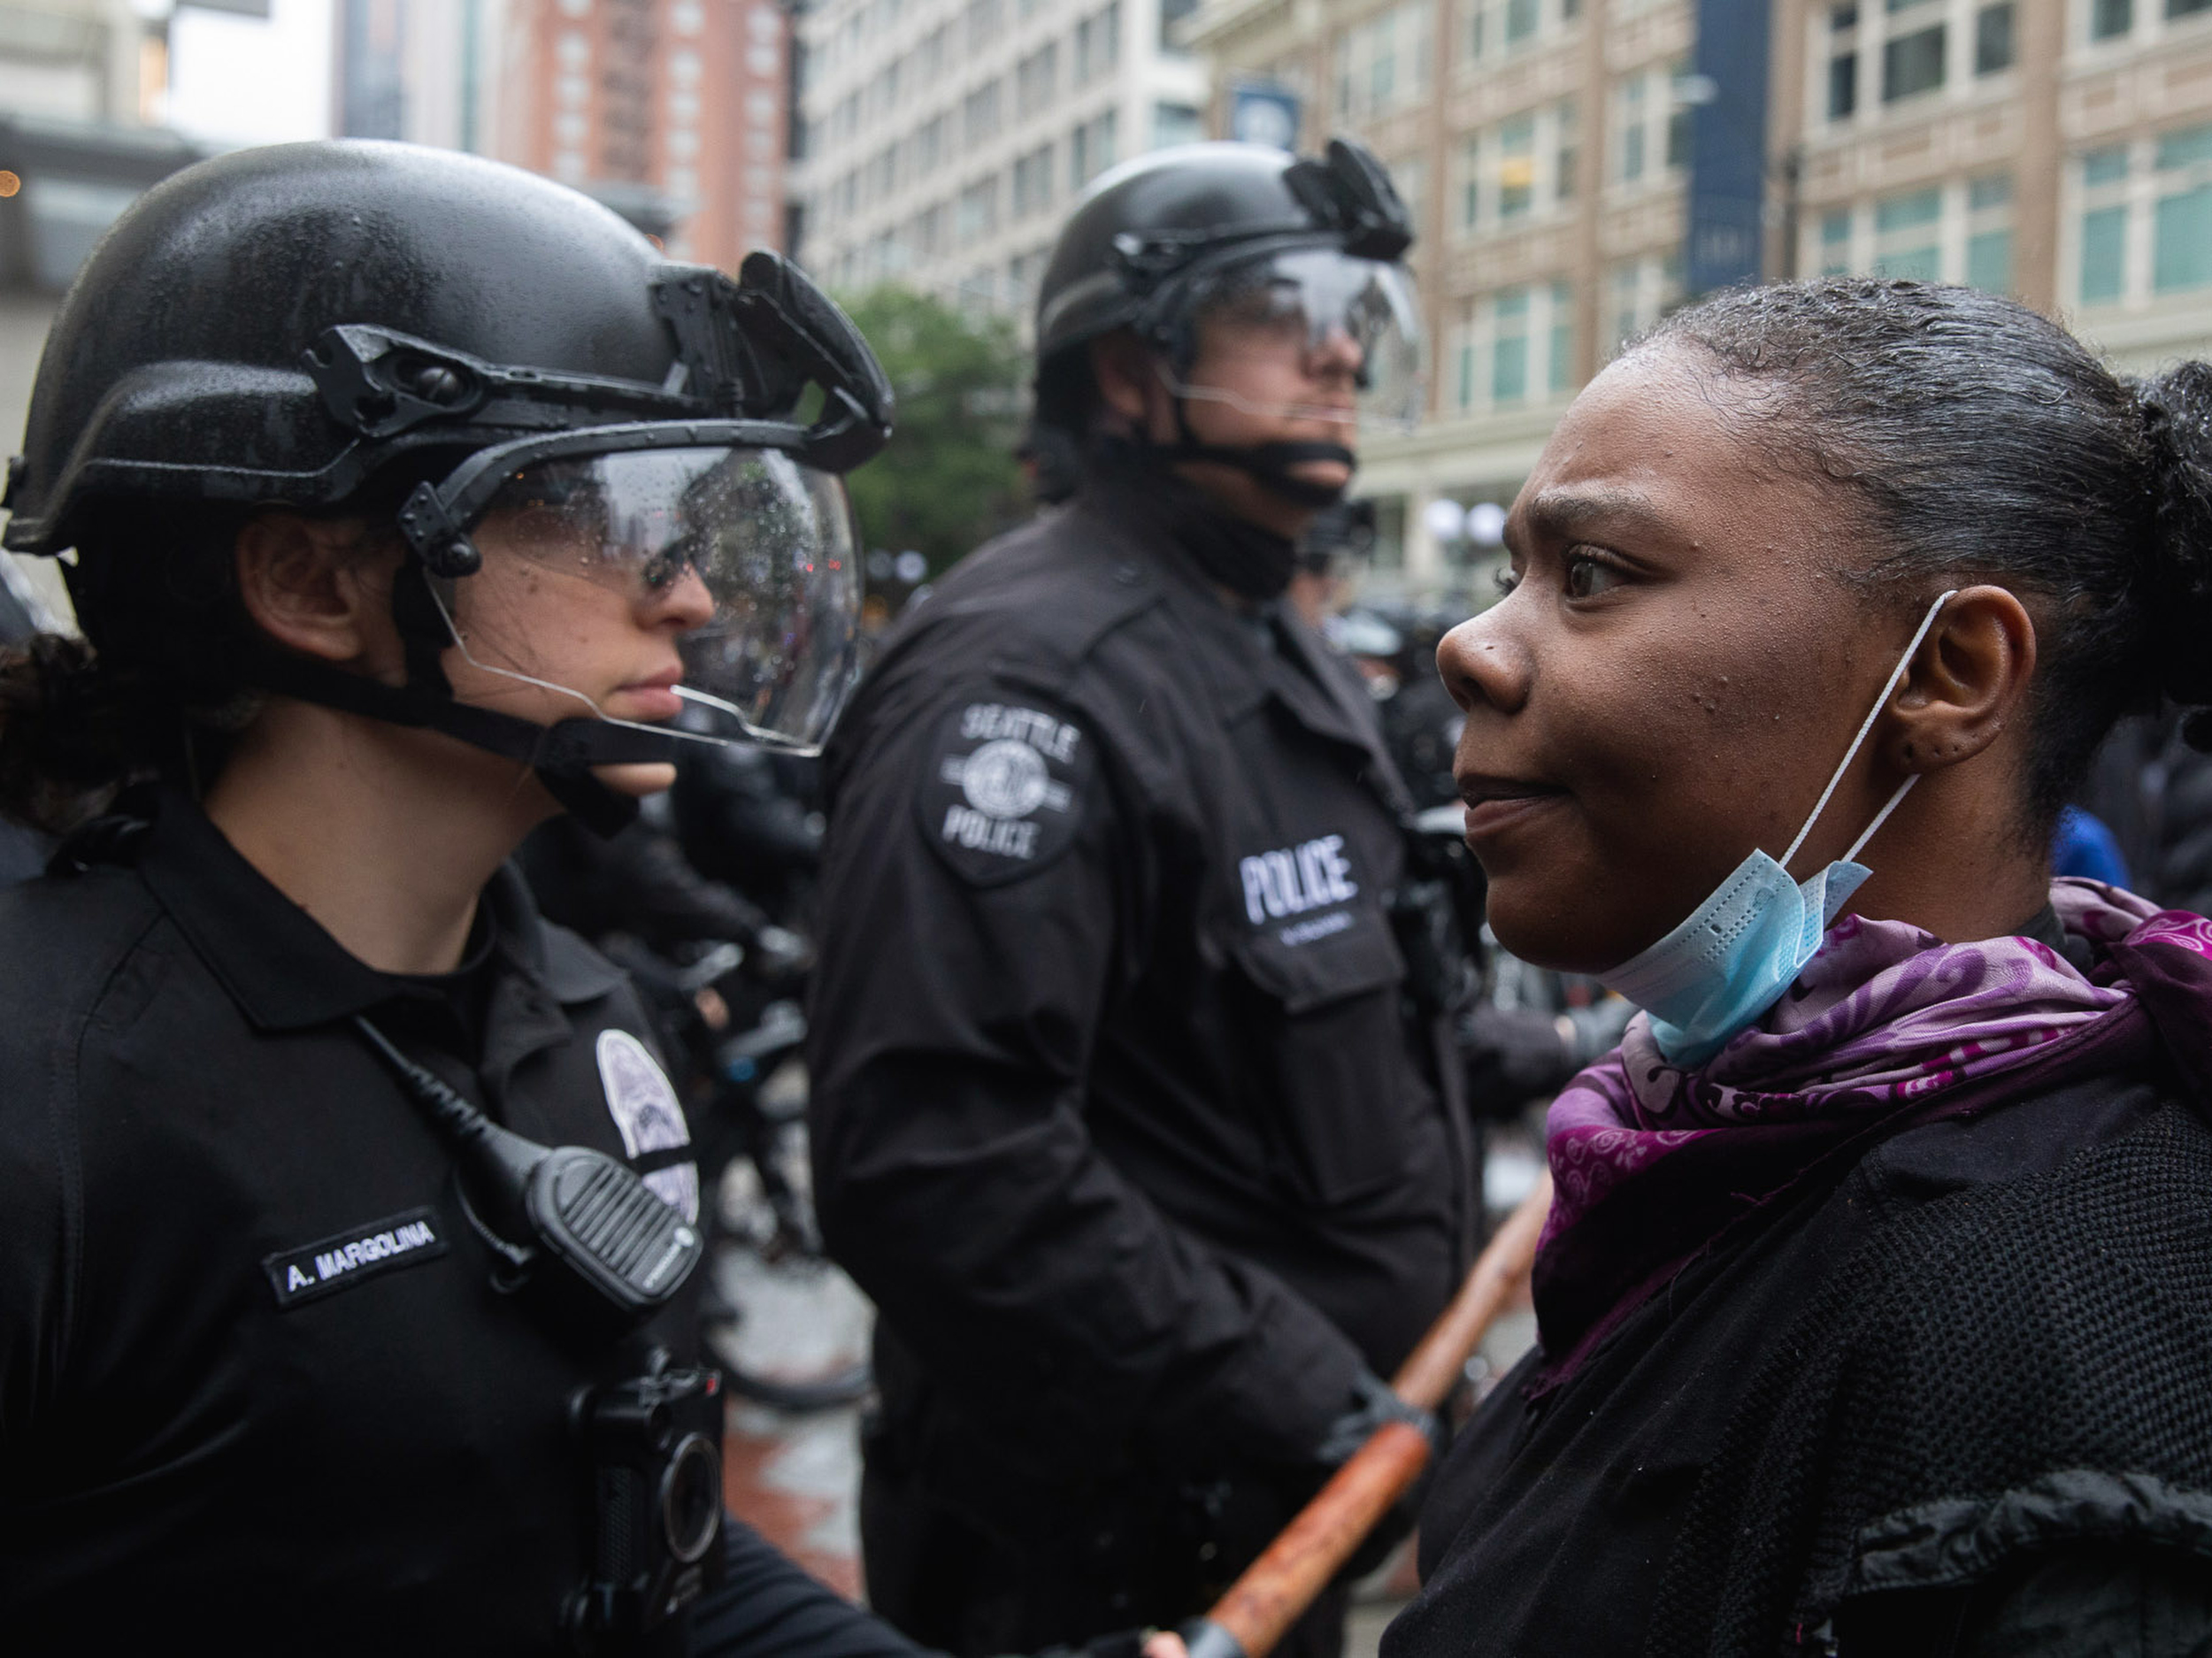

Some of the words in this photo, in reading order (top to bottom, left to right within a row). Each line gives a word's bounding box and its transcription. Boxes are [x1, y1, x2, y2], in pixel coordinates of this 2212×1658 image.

[961, 704, 1080, 764] SEATTLE
[943, 804, 1041, 859] POLICE
[1240, 835, 1358, 925] POLICE
[288, 1265, 315, 1292] A.
[315, 1221, 435, 1280] MARGOLINA
